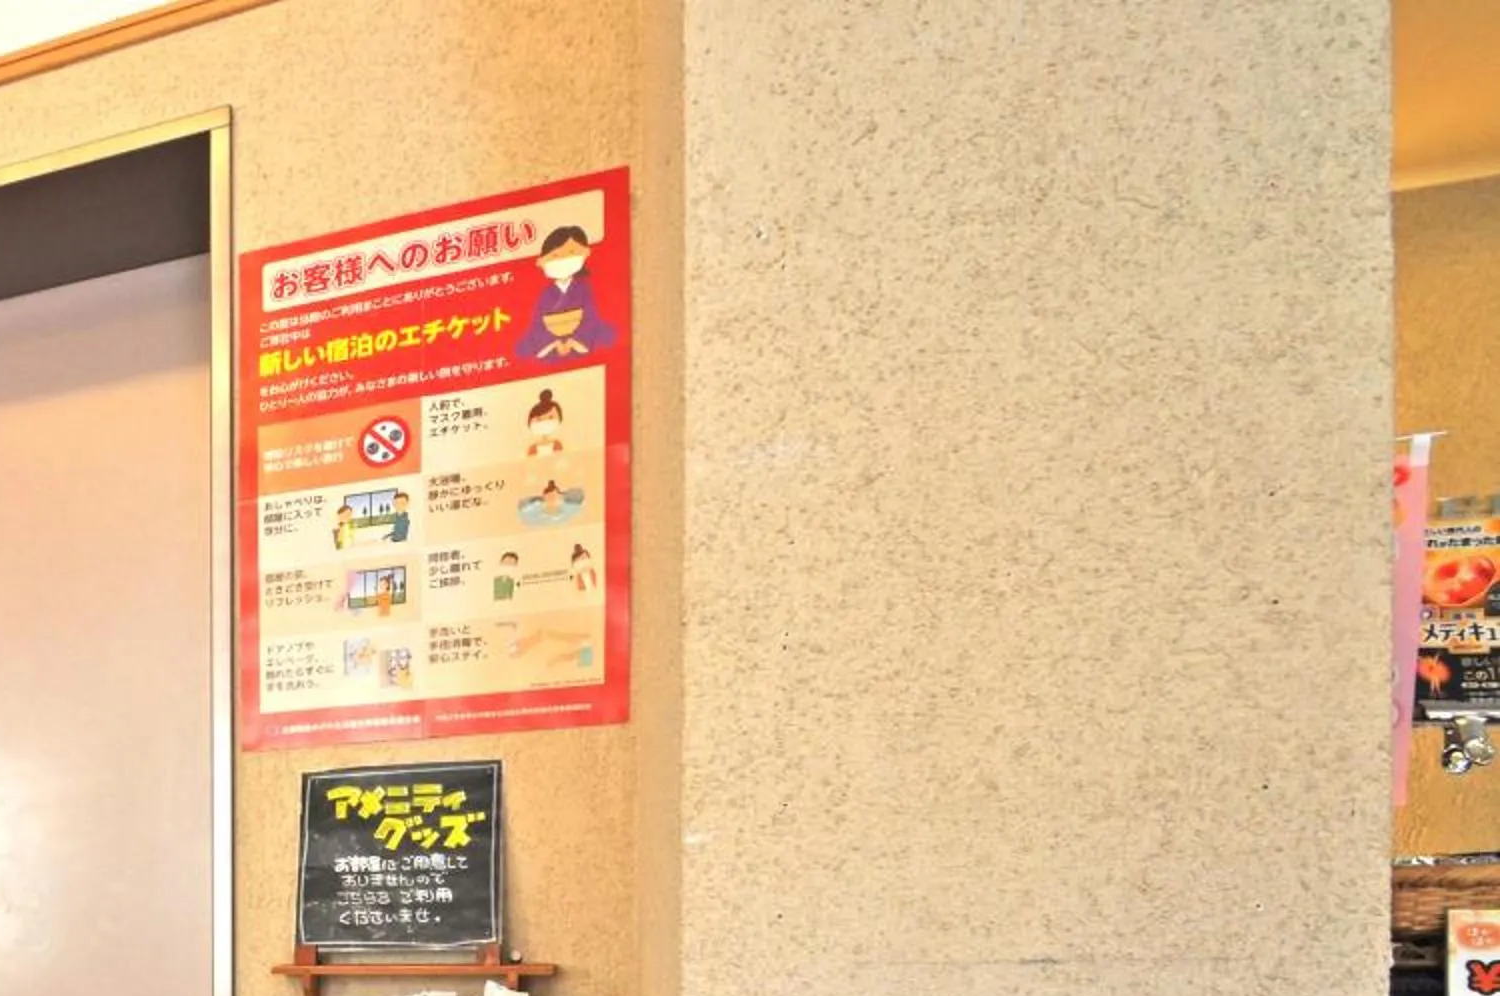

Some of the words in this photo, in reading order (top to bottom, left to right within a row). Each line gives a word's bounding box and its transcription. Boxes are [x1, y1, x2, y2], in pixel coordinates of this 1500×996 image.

[271, 221, 536, 299] お客様へのお願い
[258, 307, 512, 377] 新しい宿泊のエチケット
[326, 784, 467, 819] アメニティ
[373, 811, 486, 850] グッズ
